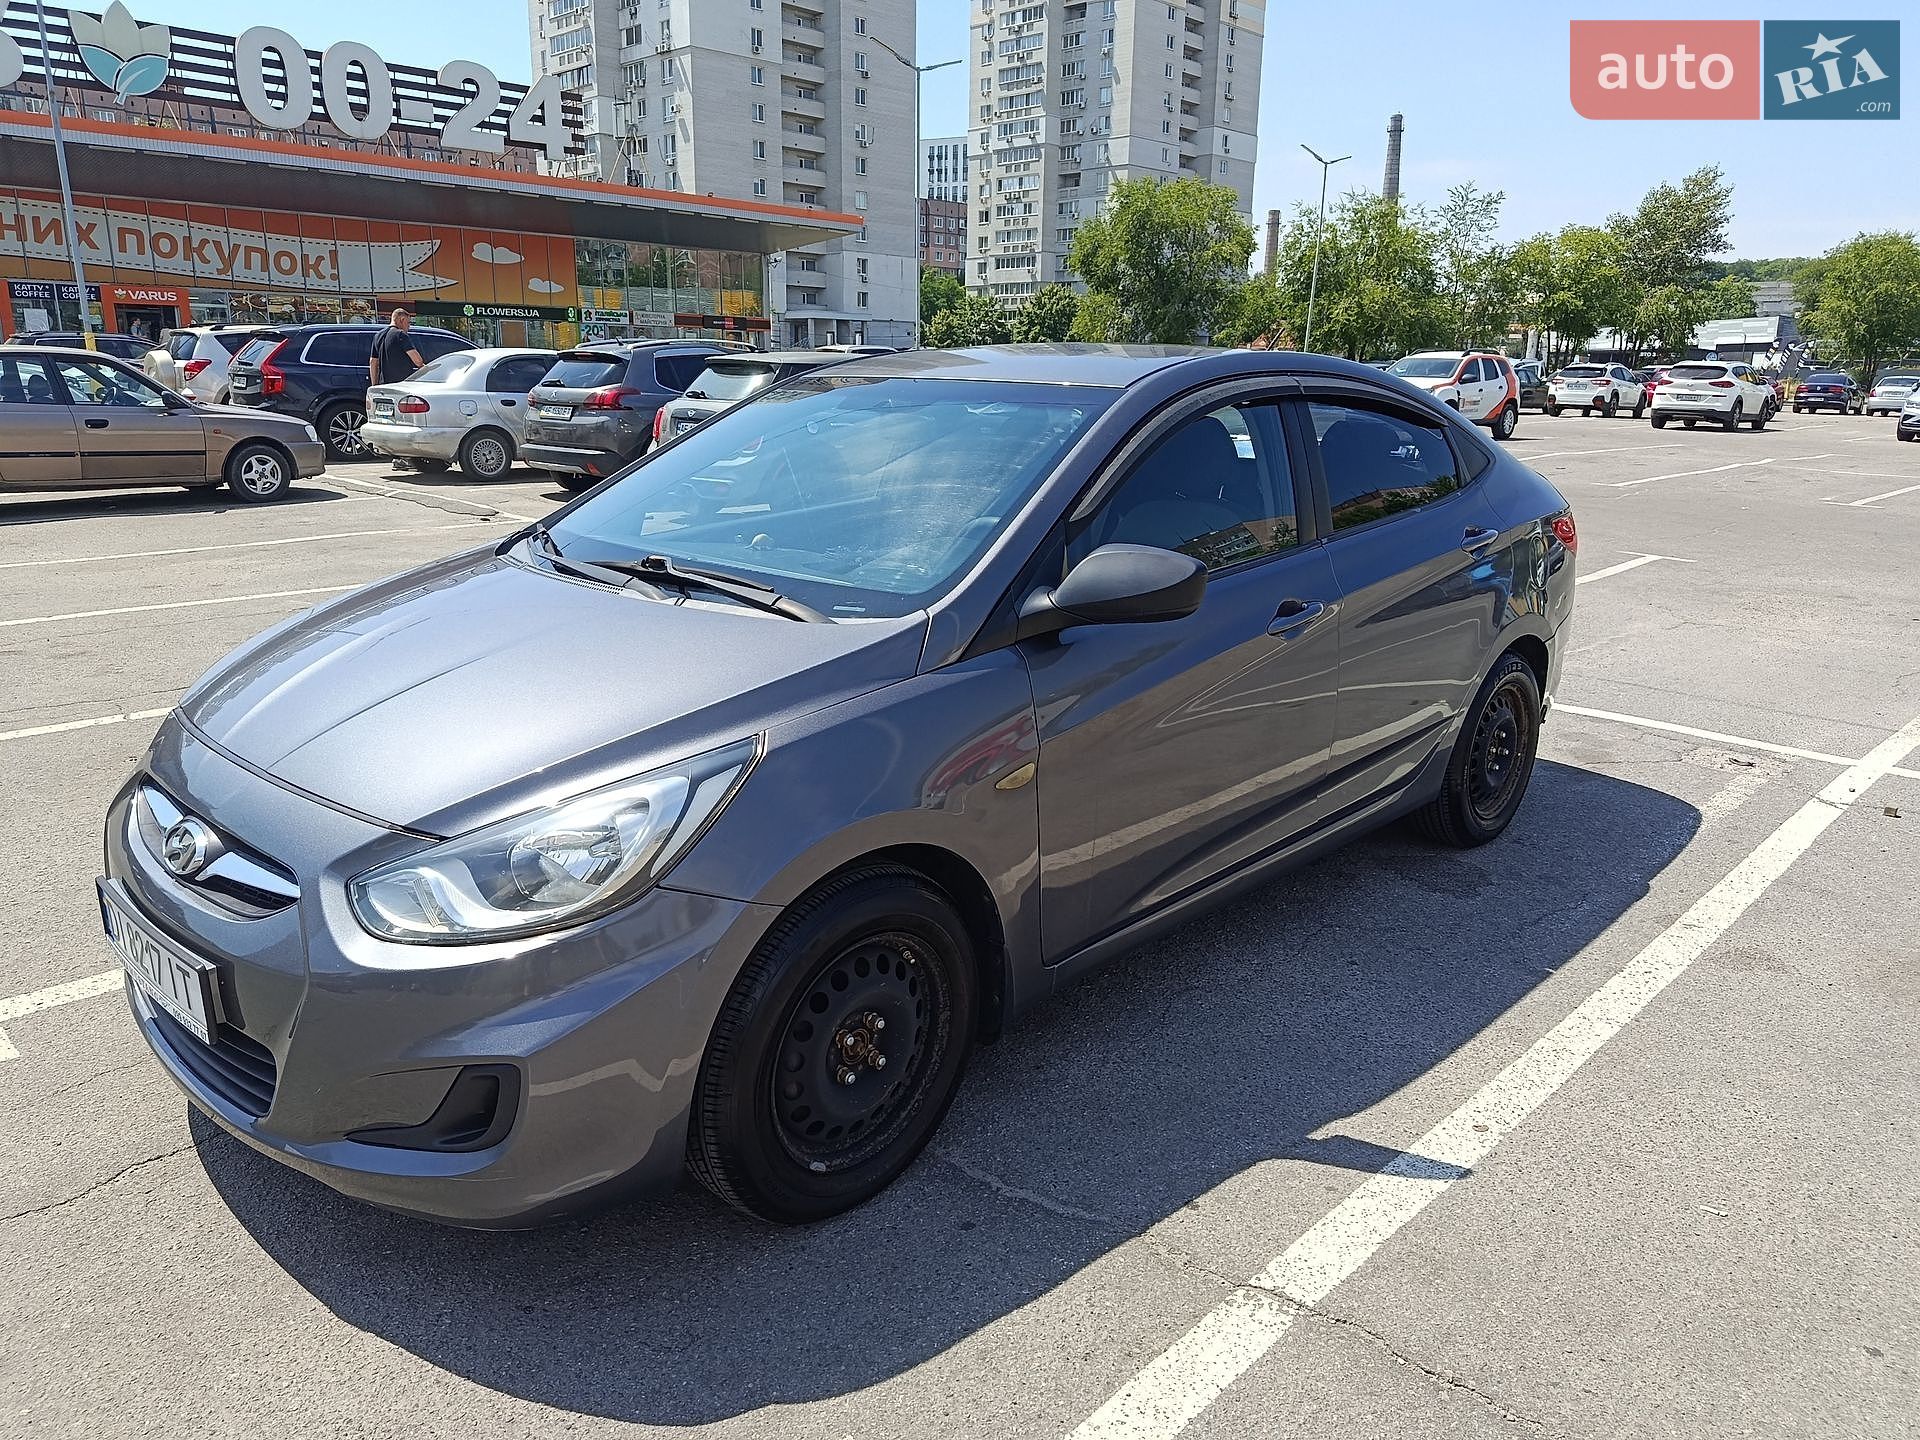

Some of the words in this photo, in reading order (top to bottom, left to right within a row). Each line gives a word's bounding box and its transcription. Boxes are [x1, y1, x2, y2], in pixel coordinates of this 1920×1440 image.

[234, 25, 573, 162] 00-24
[117, 226, 340, 282] покупок!
[14, 283, 44, 292] KATTY
[15, 290, 51, 299] COFFEE
[62, 292, 97, 300] COFEE
[128, 288, 178, 301] VARUS
[476, 307, 540, 318] FLOWERS.UA
[126, 921, 162, 987] 8217
[167, 956, 193, 1011] IT
